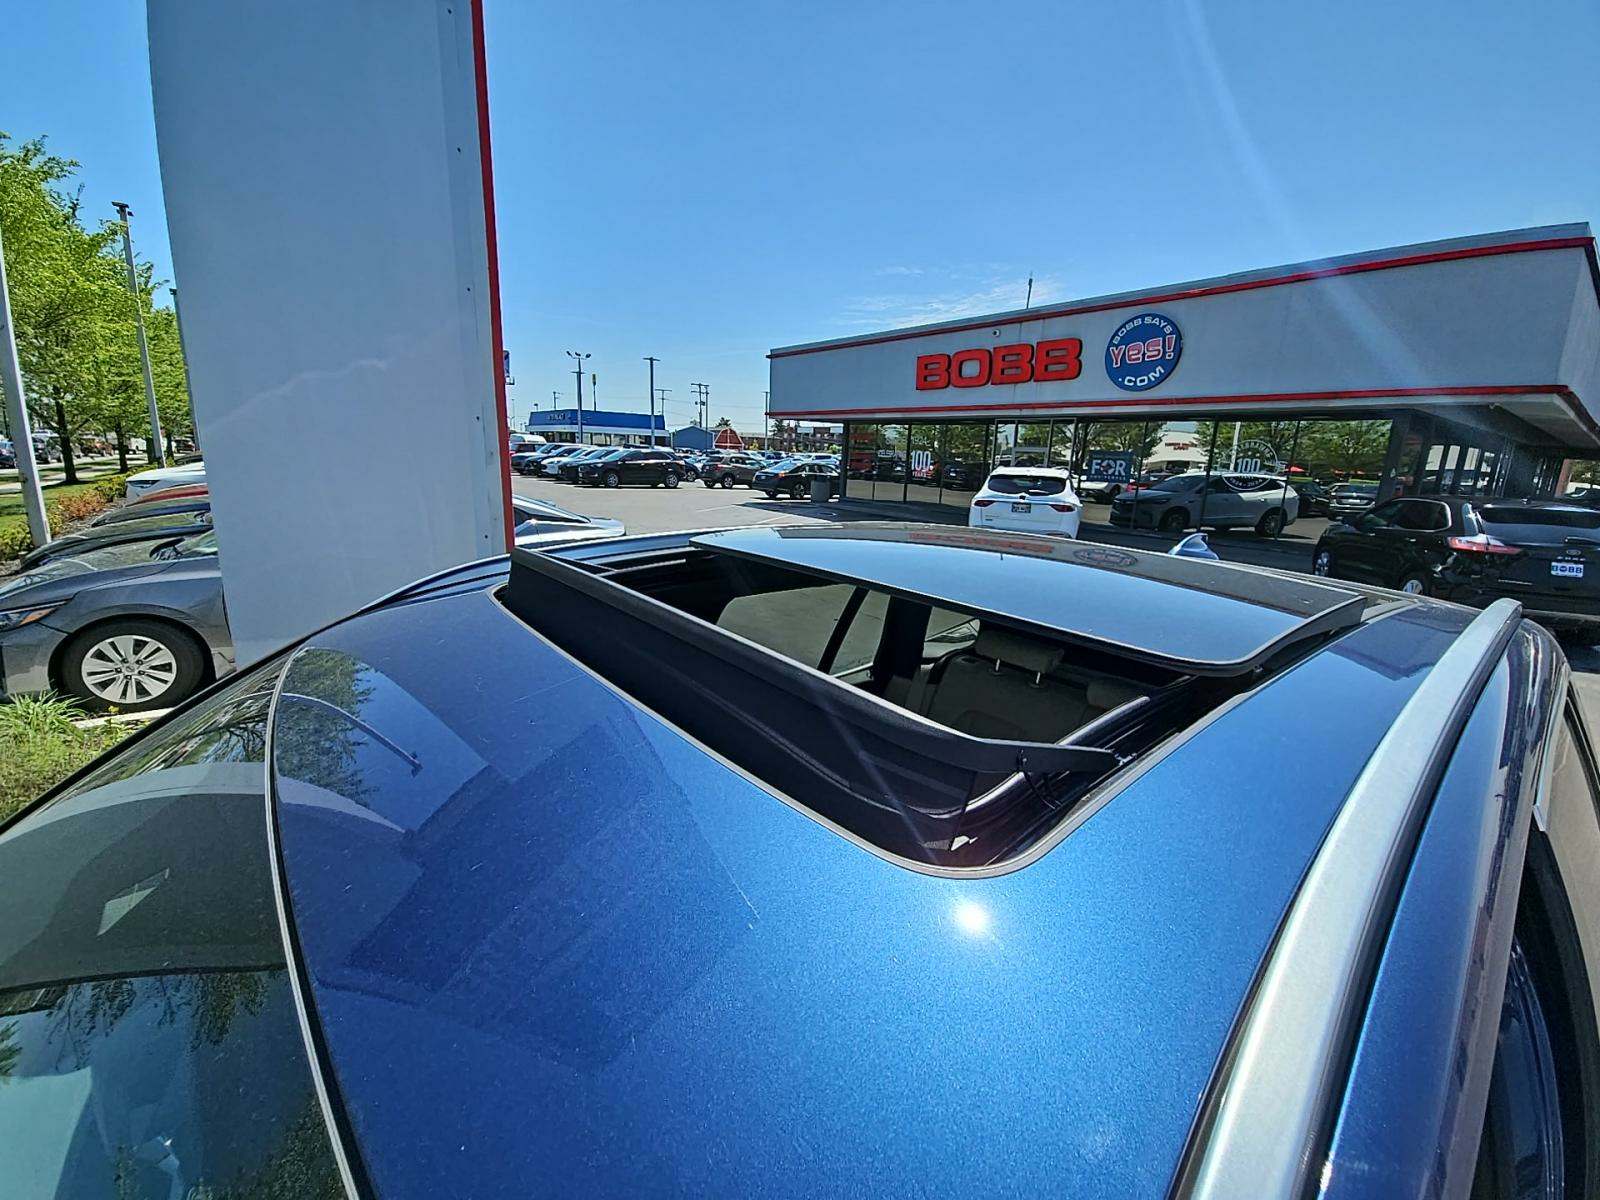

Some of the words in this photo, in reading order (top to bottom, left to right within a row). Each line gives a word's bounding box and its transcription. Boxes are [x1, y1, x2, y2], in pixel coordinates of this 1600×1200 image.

[1113, 318, 1142, 344] BOBB
[1144, 316, 1173, 334] SAYS
[916, 338, 1081, 390] BOBB
[911, 450, 931, 470] 100
[1091, 459, 1126, 476] FOR
[1237, 457, 1261, 474] 100
